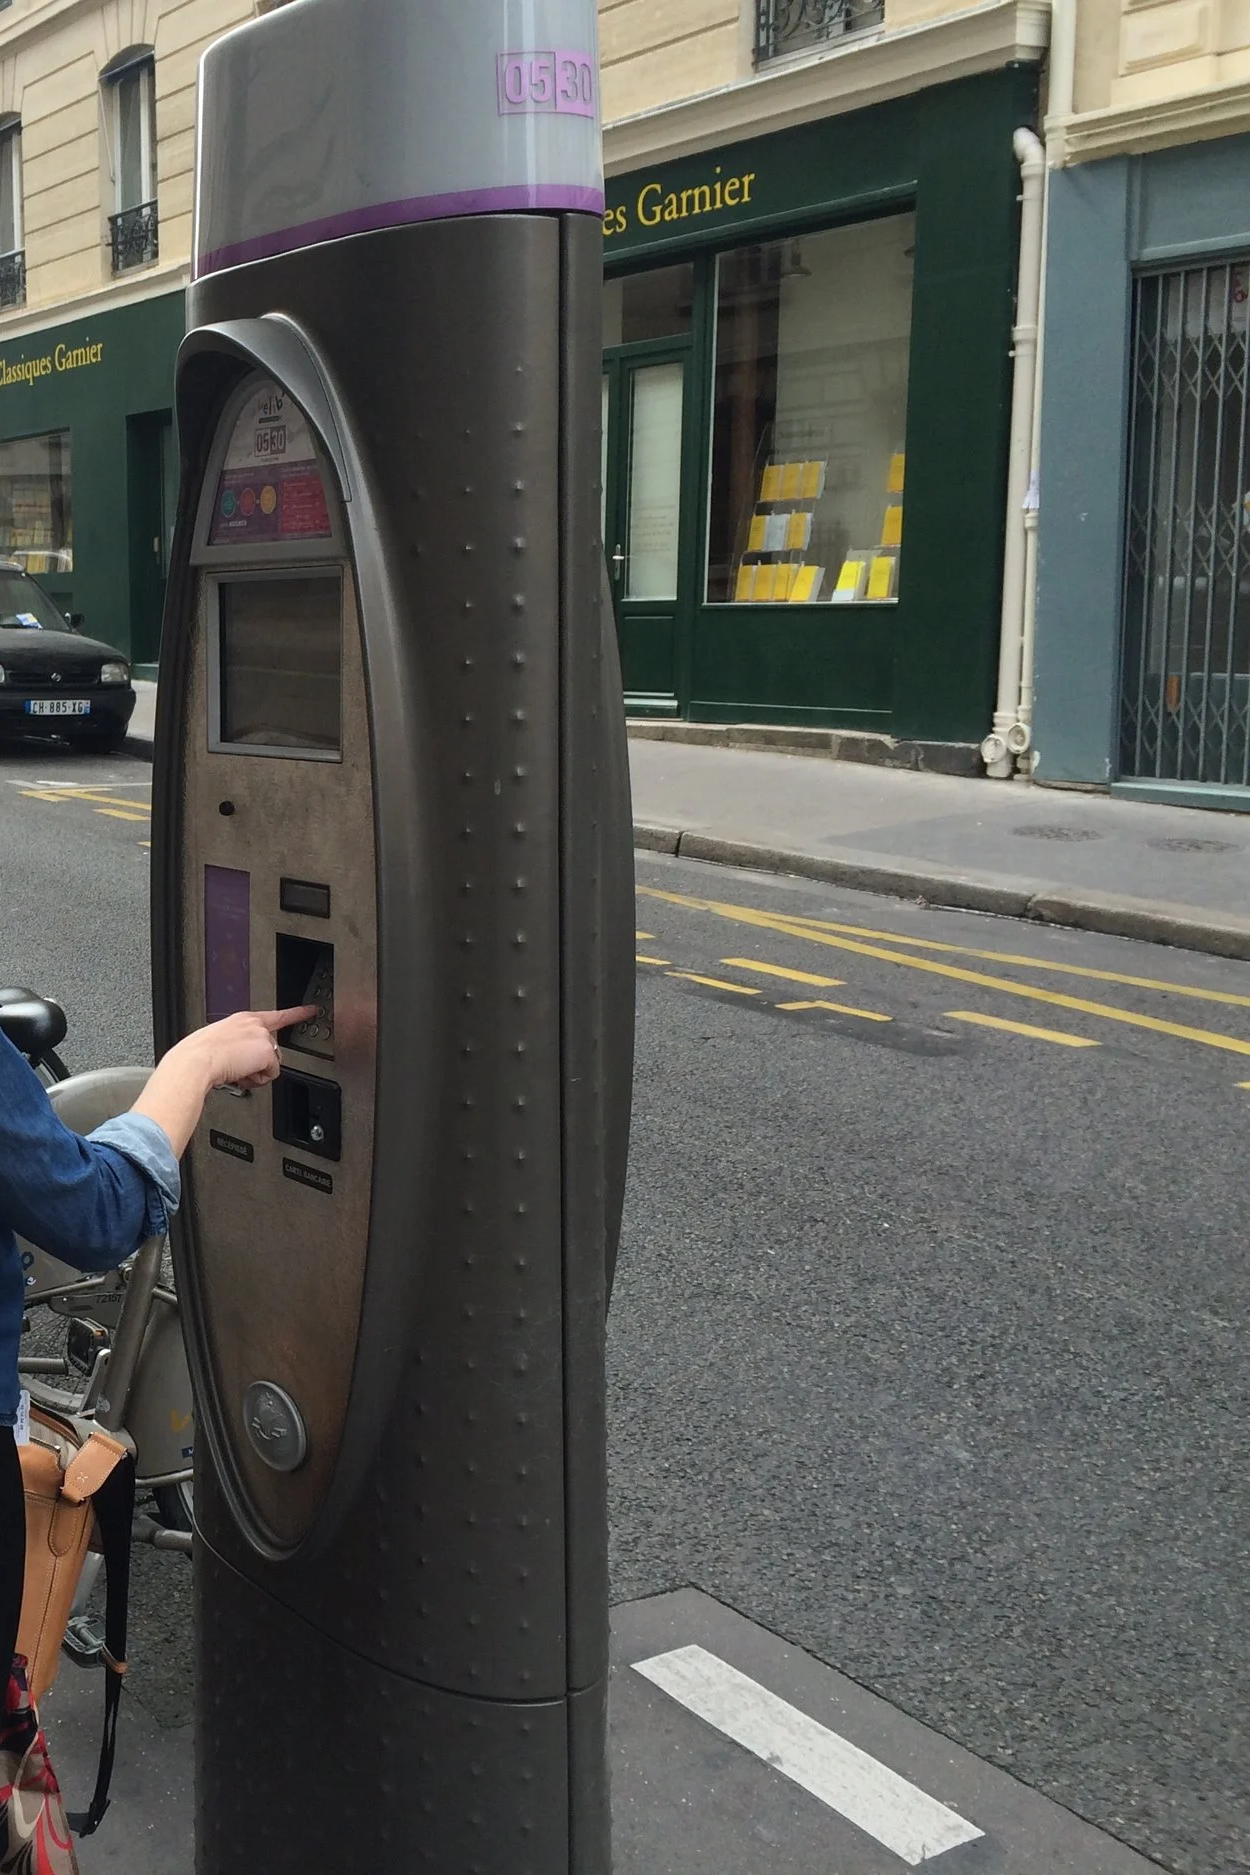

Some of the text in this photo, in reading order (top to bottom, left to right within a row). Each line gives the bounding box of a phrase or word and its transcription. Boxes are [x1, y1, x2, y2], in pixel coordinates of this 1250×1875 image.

[637, 165, 756, 226] Garnier
[54, 336, 103, 372] Garnier
[256, 430, 285, 453] 0530
